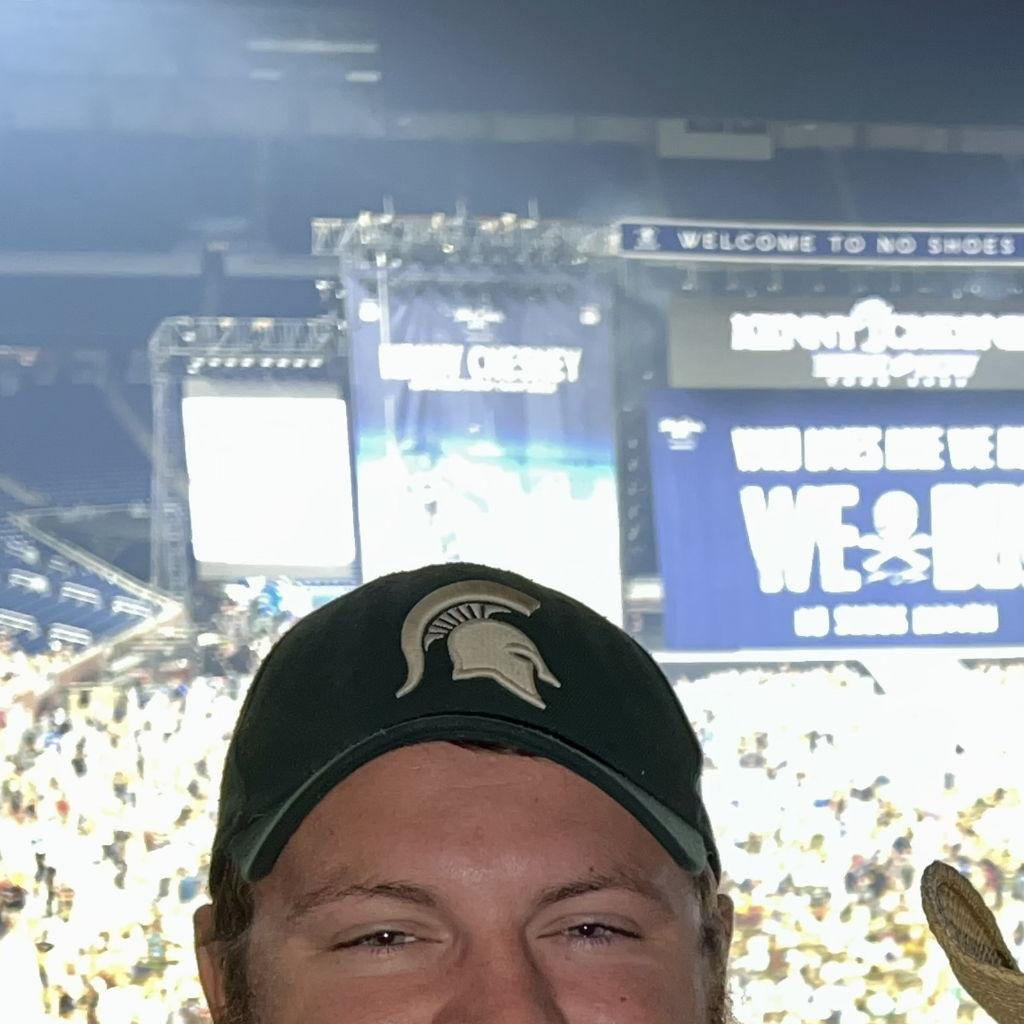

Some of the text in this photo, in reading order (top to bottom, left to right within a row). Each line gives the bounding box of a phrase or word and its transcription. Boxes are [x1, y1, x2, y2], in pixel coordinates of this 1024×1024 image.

[676, 230, 817, 254] WELCOME
[827, 232, 867, 254] TO
[876, 234, 918, 255] NO
[927, 234, 1016, 256] SHOES
[739, 485, 862, 593] WE
